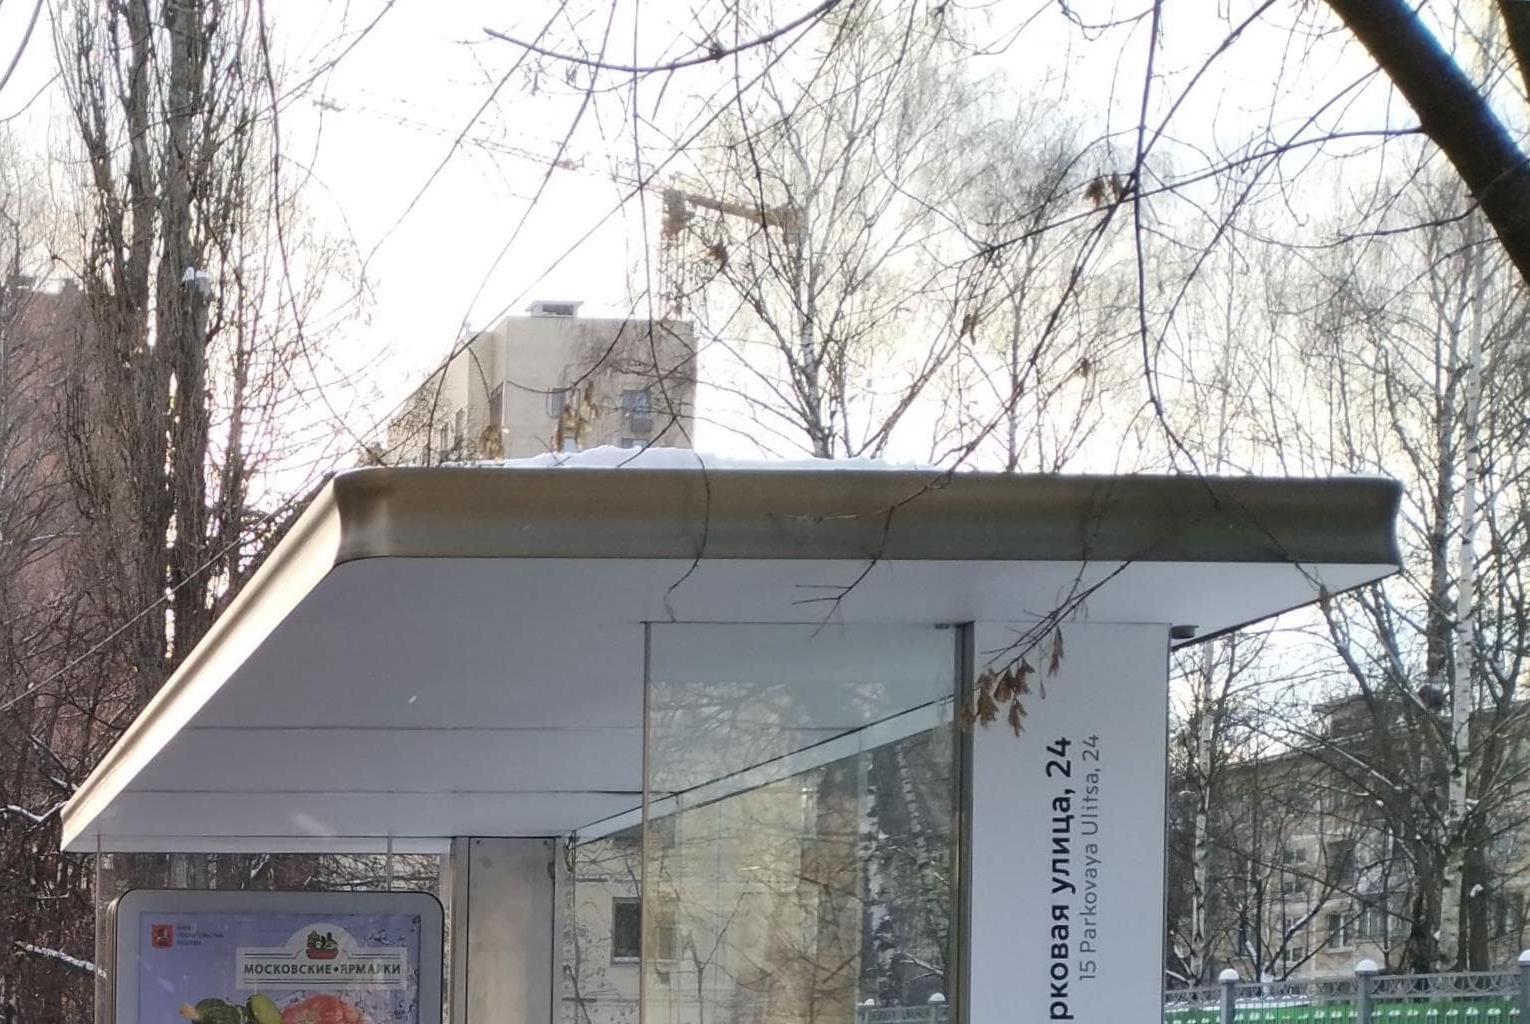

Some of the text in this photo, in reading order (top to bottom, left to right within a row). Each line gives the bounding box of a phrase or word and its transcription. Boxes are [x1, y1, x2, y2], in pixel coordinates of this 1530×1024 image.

[1045, 737, 1072, 778] 24
[1052, 788, 1076, 895] улица,
[1079, 734, 1102, 980] 15 Parkovaya Ulitsa, 24
